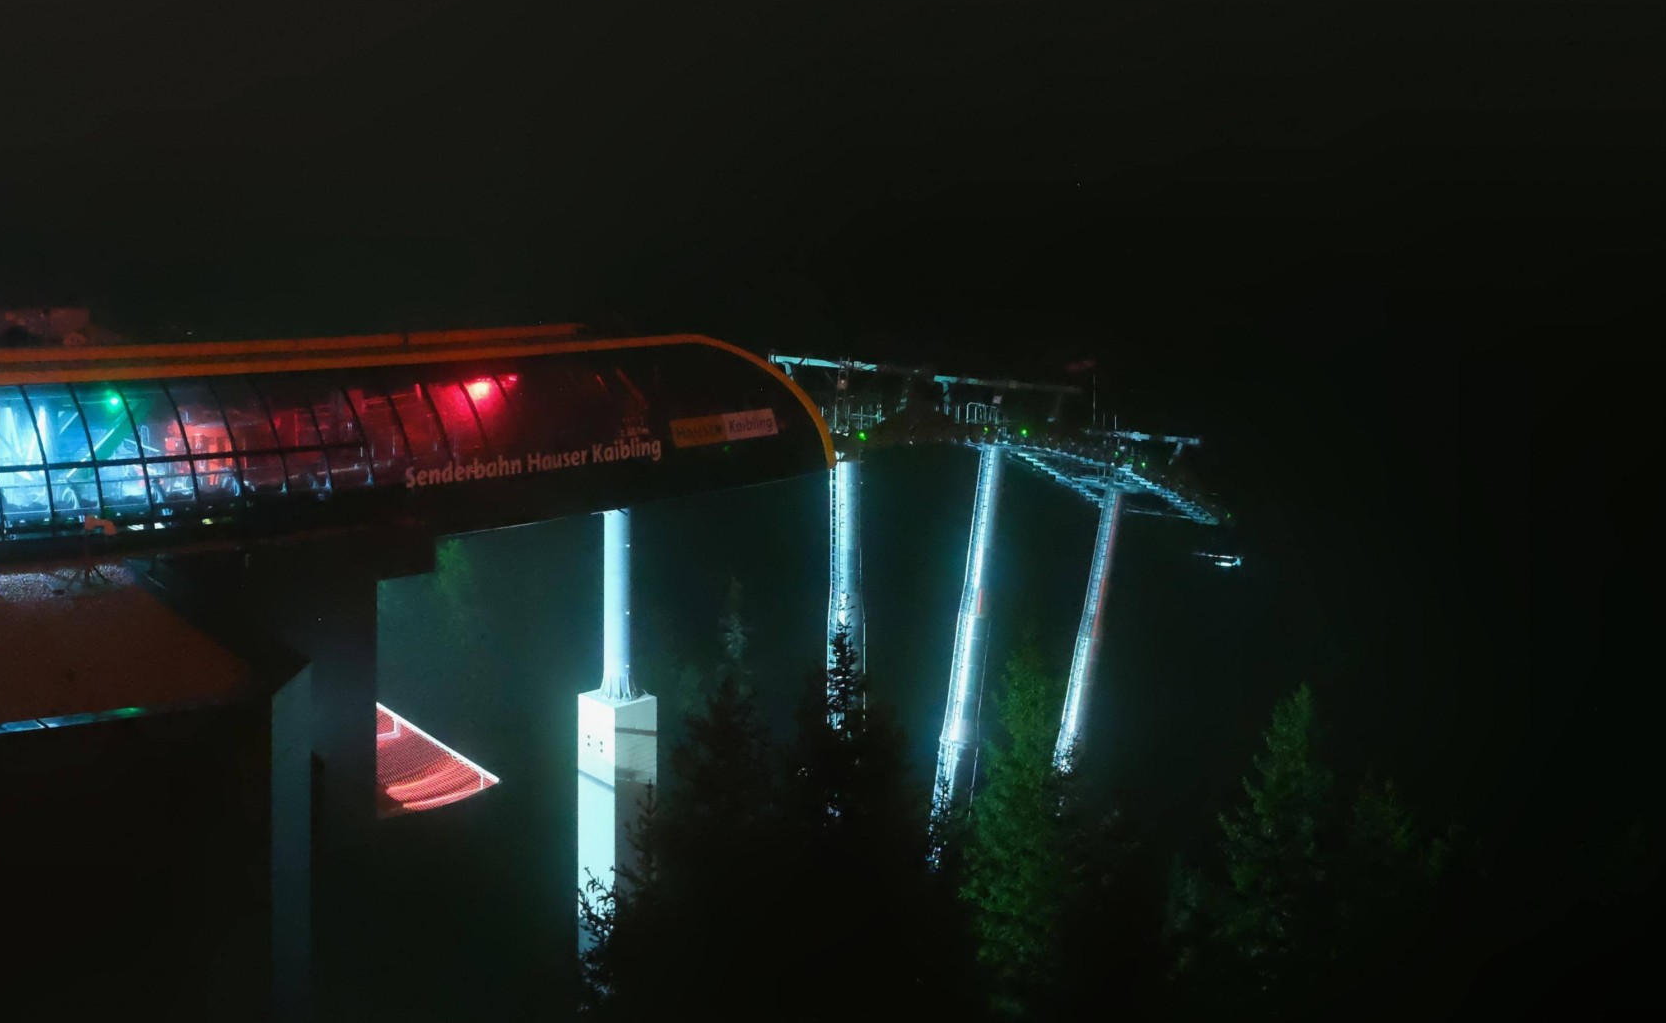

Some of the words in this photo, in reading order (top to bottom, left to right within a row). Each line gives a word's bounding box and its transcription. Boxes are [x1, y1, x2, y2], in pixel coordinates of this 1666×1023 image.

[728, 418, 774, 433] Kaibling
[405, 457, 523, 489] Senderbahn
[528, 448, 588, 474] Hauser
[592, 437, 662, 462] Kaibling
